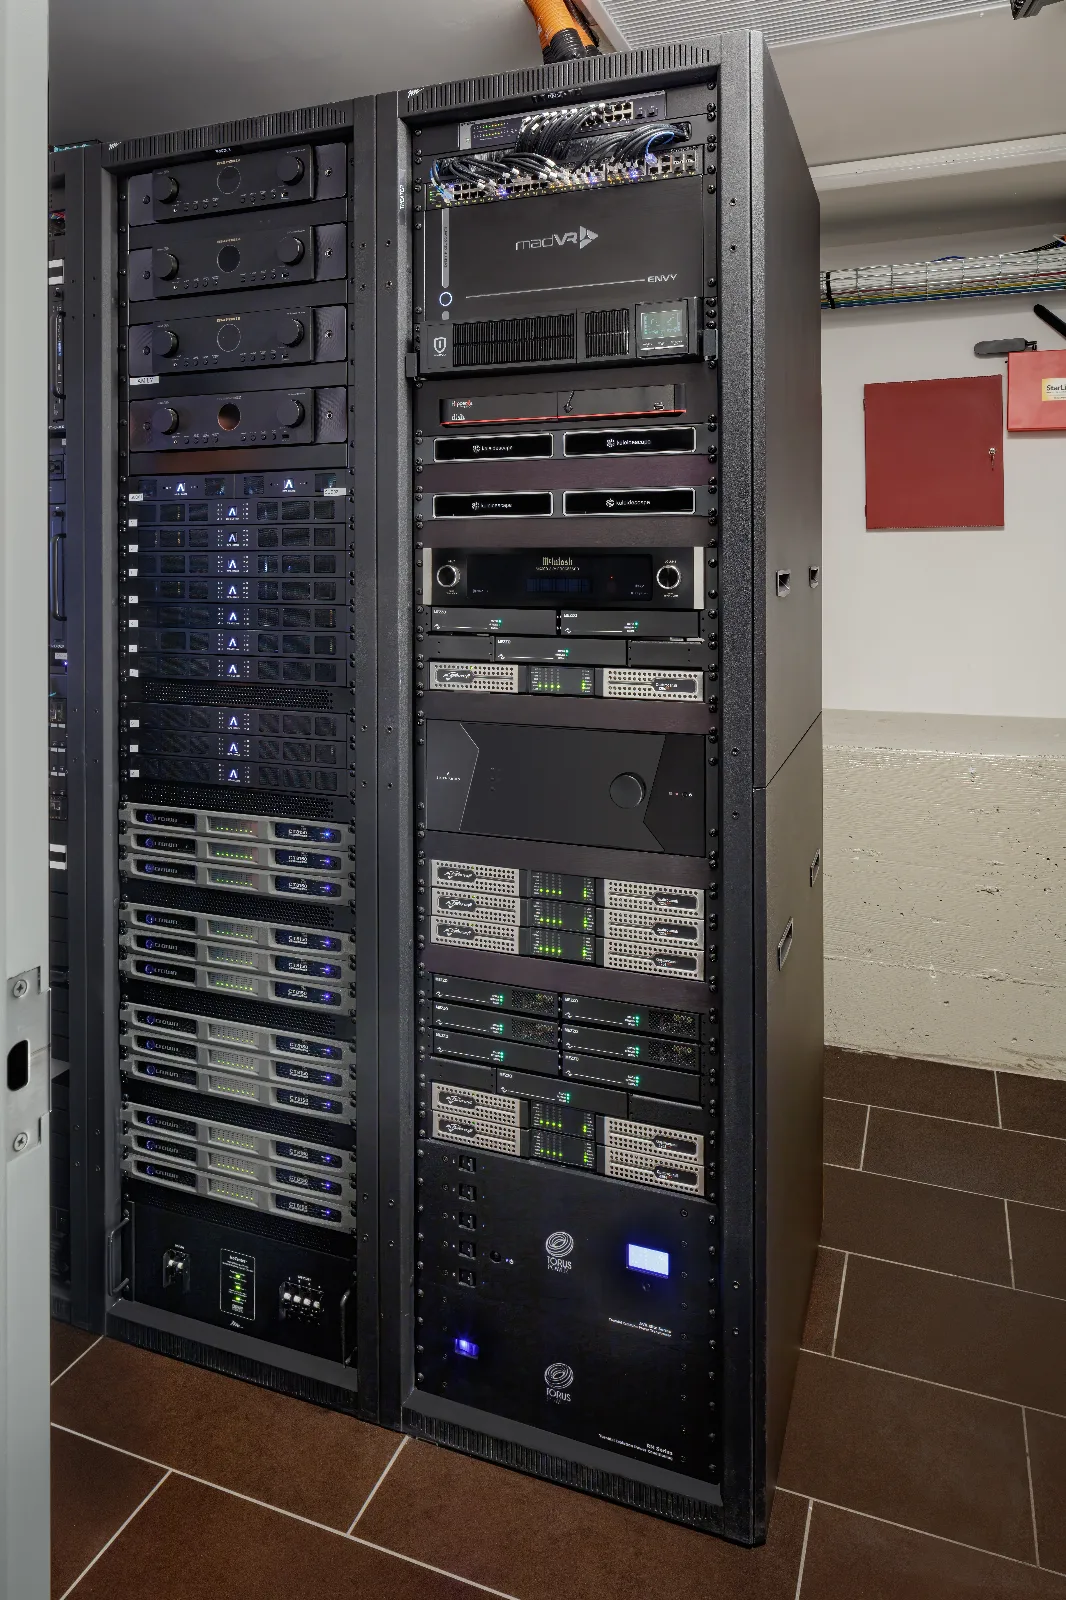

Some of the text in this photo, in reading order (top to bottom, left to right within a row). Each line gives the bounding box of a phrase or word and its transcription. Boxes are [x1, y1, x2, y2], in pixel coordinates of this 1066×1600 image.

[515, 231, 578, 251] madVR
[647, 273, 677, 283] ENVY
[546, 1255, 572, 1270] TORUS
[546, 1387, 572, 1402] TORUS
